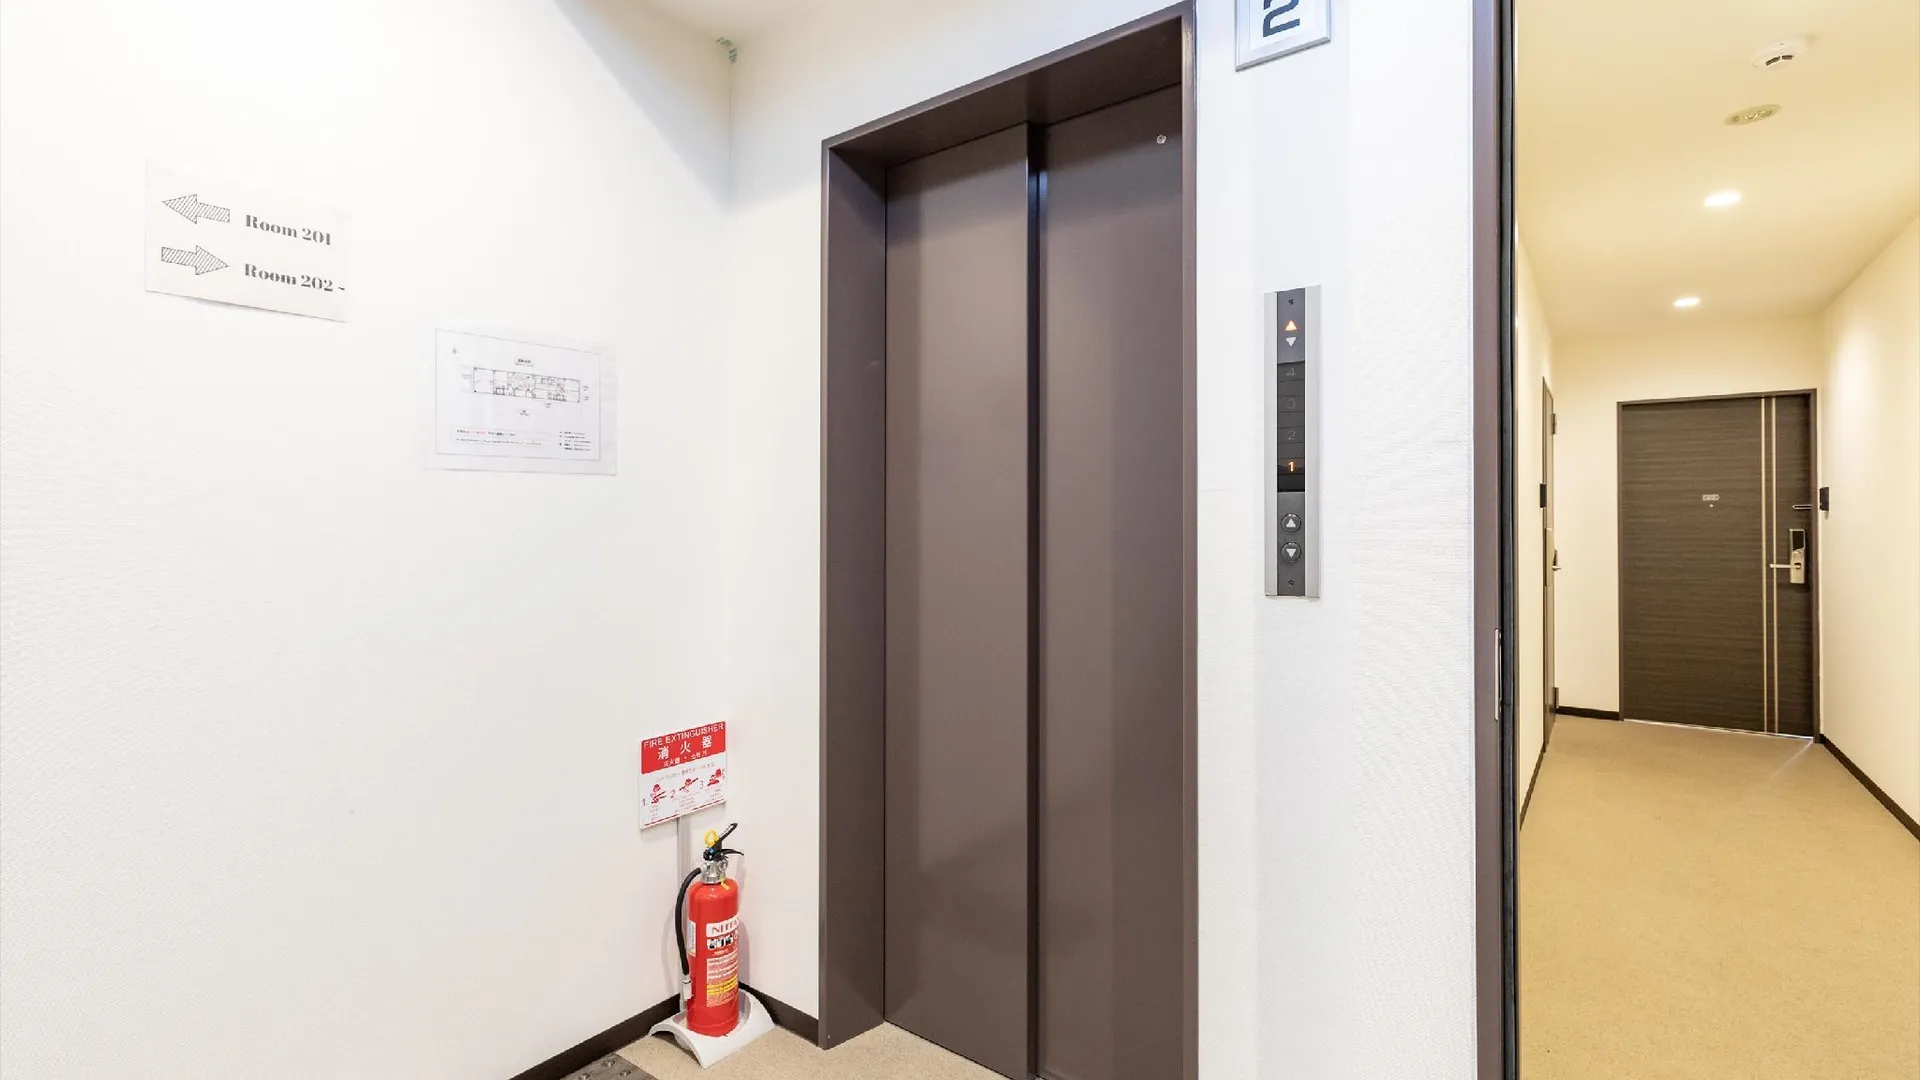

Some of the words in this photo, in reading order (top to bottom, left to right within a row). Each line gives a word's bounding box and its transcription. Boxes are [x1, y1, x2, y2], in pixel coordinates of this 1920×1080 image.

[1262, 0, 1301, 37] 2
[245, 214, 298, 238] Room
[302, 228, 331, 245] 201
[244, 263, 297, 285] Room
[301, 275, 333, 292] 202
[1288, 461, 1295, 472] 1
[643, 737, 664, 750] FIRE
[665, 723, 724, 744] EXTINGUISHER
[657, 735, 712, 760] 消火器
